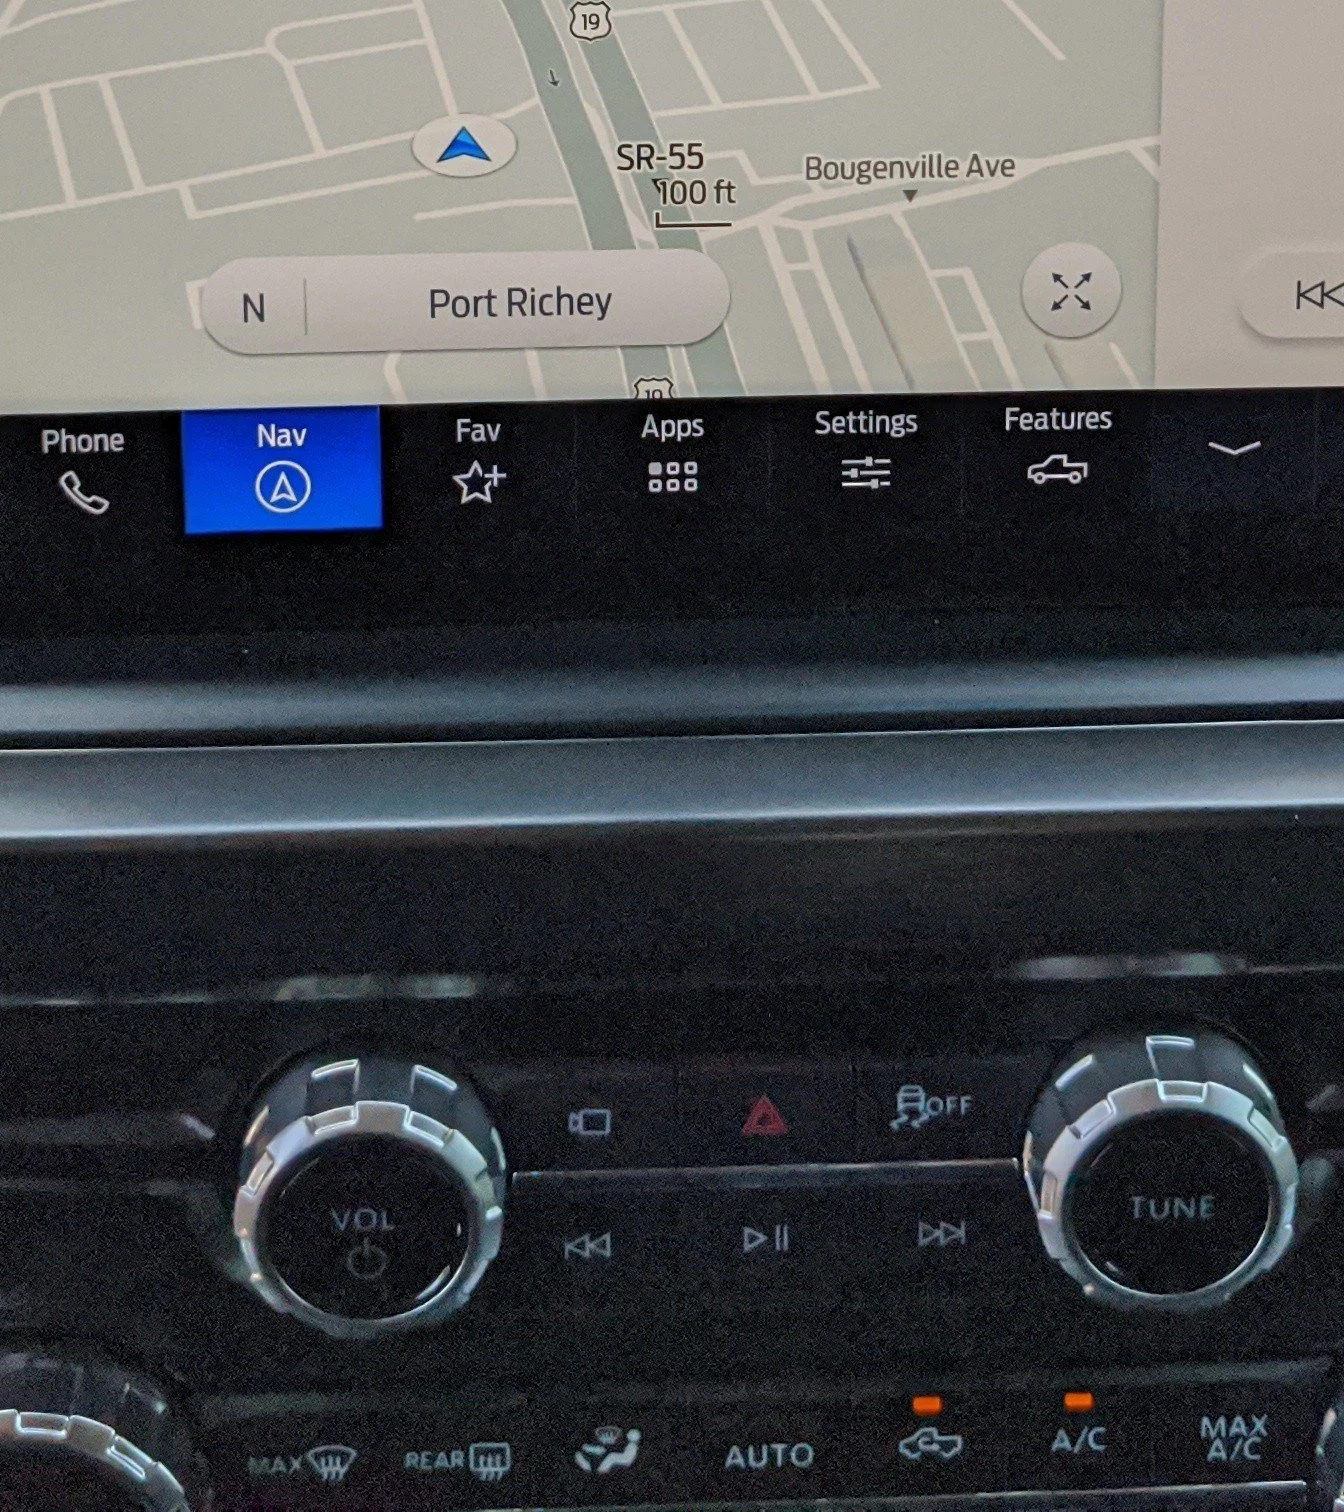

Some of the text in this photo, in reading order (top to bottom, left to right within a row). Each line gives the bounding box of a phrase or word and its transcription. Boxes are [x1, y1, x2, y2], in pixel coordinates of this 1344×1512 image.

[581, 12, 602, 32] 19
[616, 142, 705, 171] SR-55
[805, 153, 1016, 183] Bougenville Ave
[713, 179, 737, 206] ft
[242, 292, 266, 323] N
[429, 286, 612, 322] Port Richey
[456, 418, 502, 444] Fav
[641, 413, 705, 441] Apps
[814, 410, 919, 438] Settings
[1004, 406, 1114, 432] Features
[41, 428, 126, 455] Phone
[257, 423, 308, 449] Nav
[926, 1094, 973, 1117] OFF
[331, 1207, 396, 1233] VOL
[1130, 1194, 1216, 1221] TUNE
[1051, 1425, 1107, 1454] A/C
[1199, 1413, 1268, 1439] MAX
[405, 1450, 465, 1471] REAR
[724, 1442, 814, 1470] AUTO
[1206, 1436, 1262, 1462] A/C
